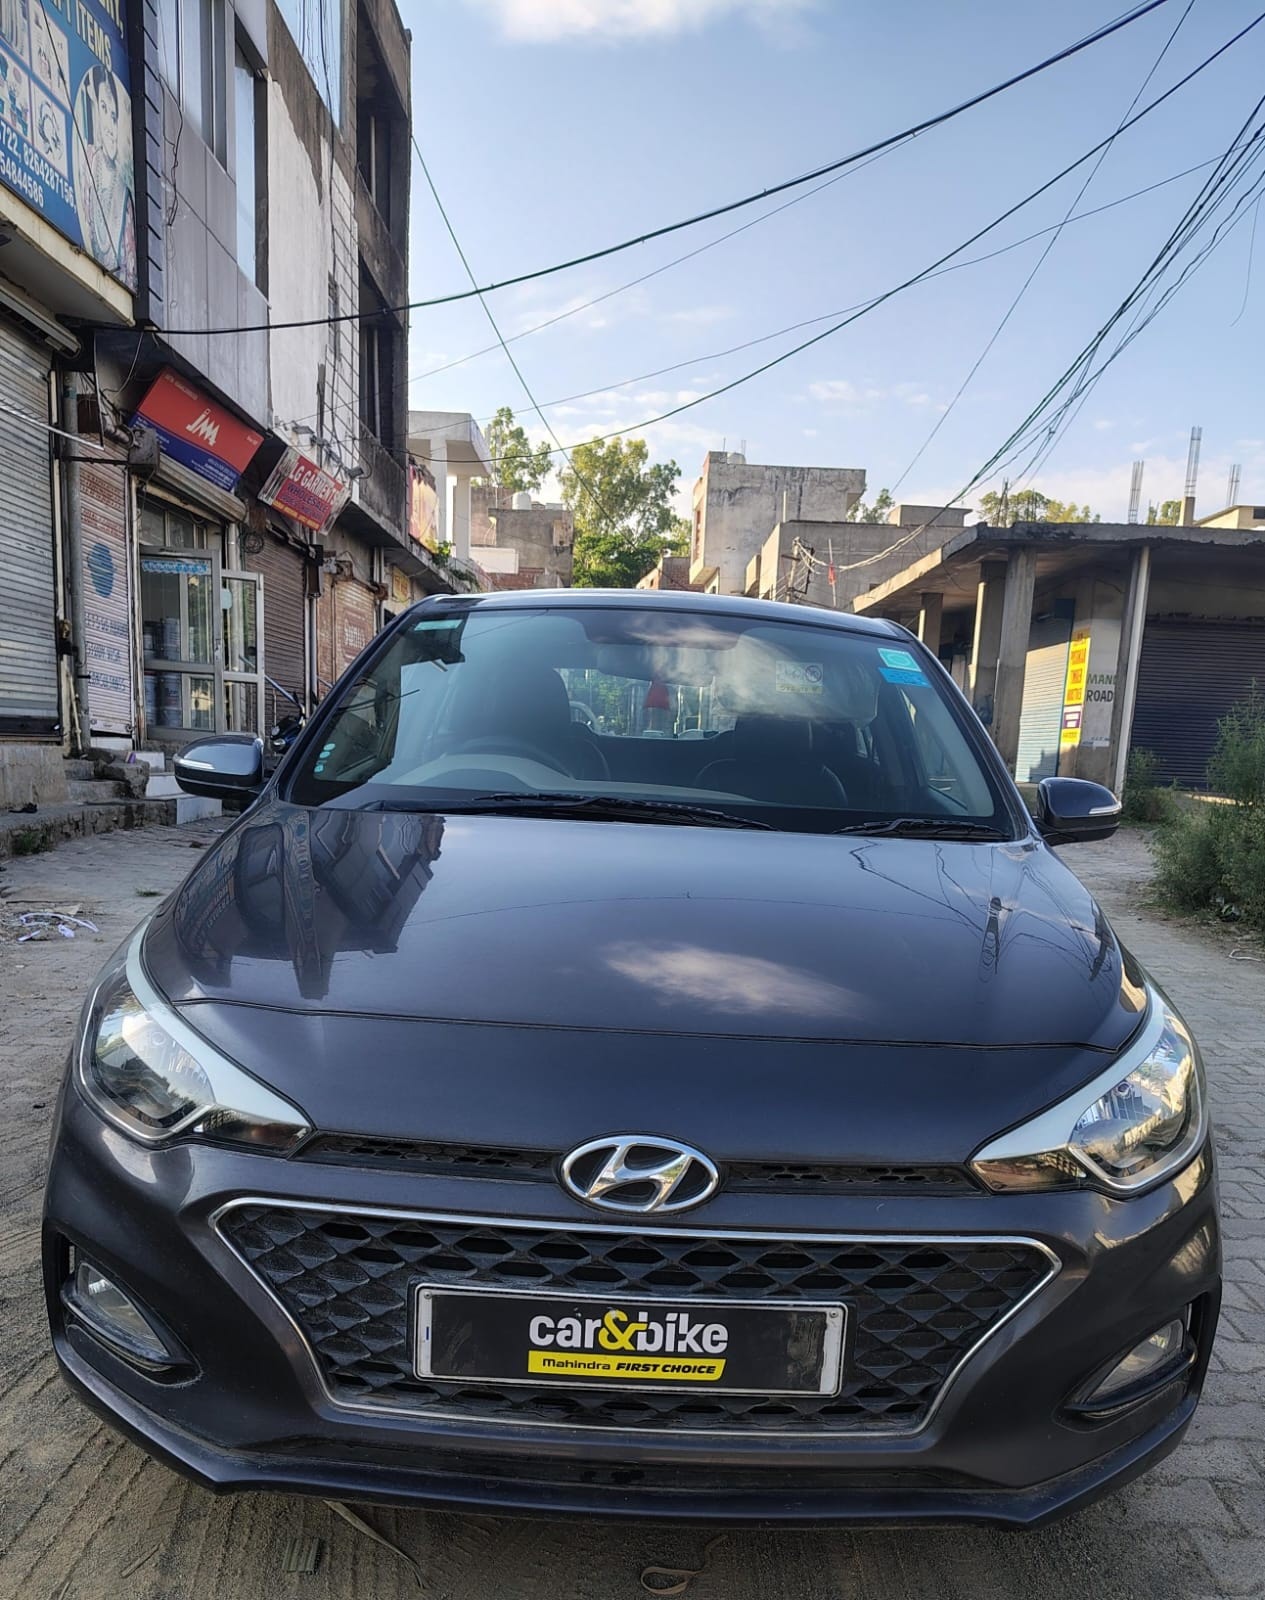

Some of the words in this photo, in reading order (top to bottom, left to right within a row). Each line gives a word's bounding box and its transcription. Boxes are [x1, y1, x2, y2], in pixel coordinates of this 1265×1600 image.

[75, 0, 113, 72] ITEMS
[0, 120, 21, 163] 722,
[287, 484, 329, 513] WHOLESALE
[1086, 689, 1114, 702] ROAD
[529, 1308, 729, 1354] car&bike
[542, 1357, 611, 1371] Mahindra
[616, 1362, 661, 1373] FIRST
[661, 1363, 717, 1375] CHOICE
